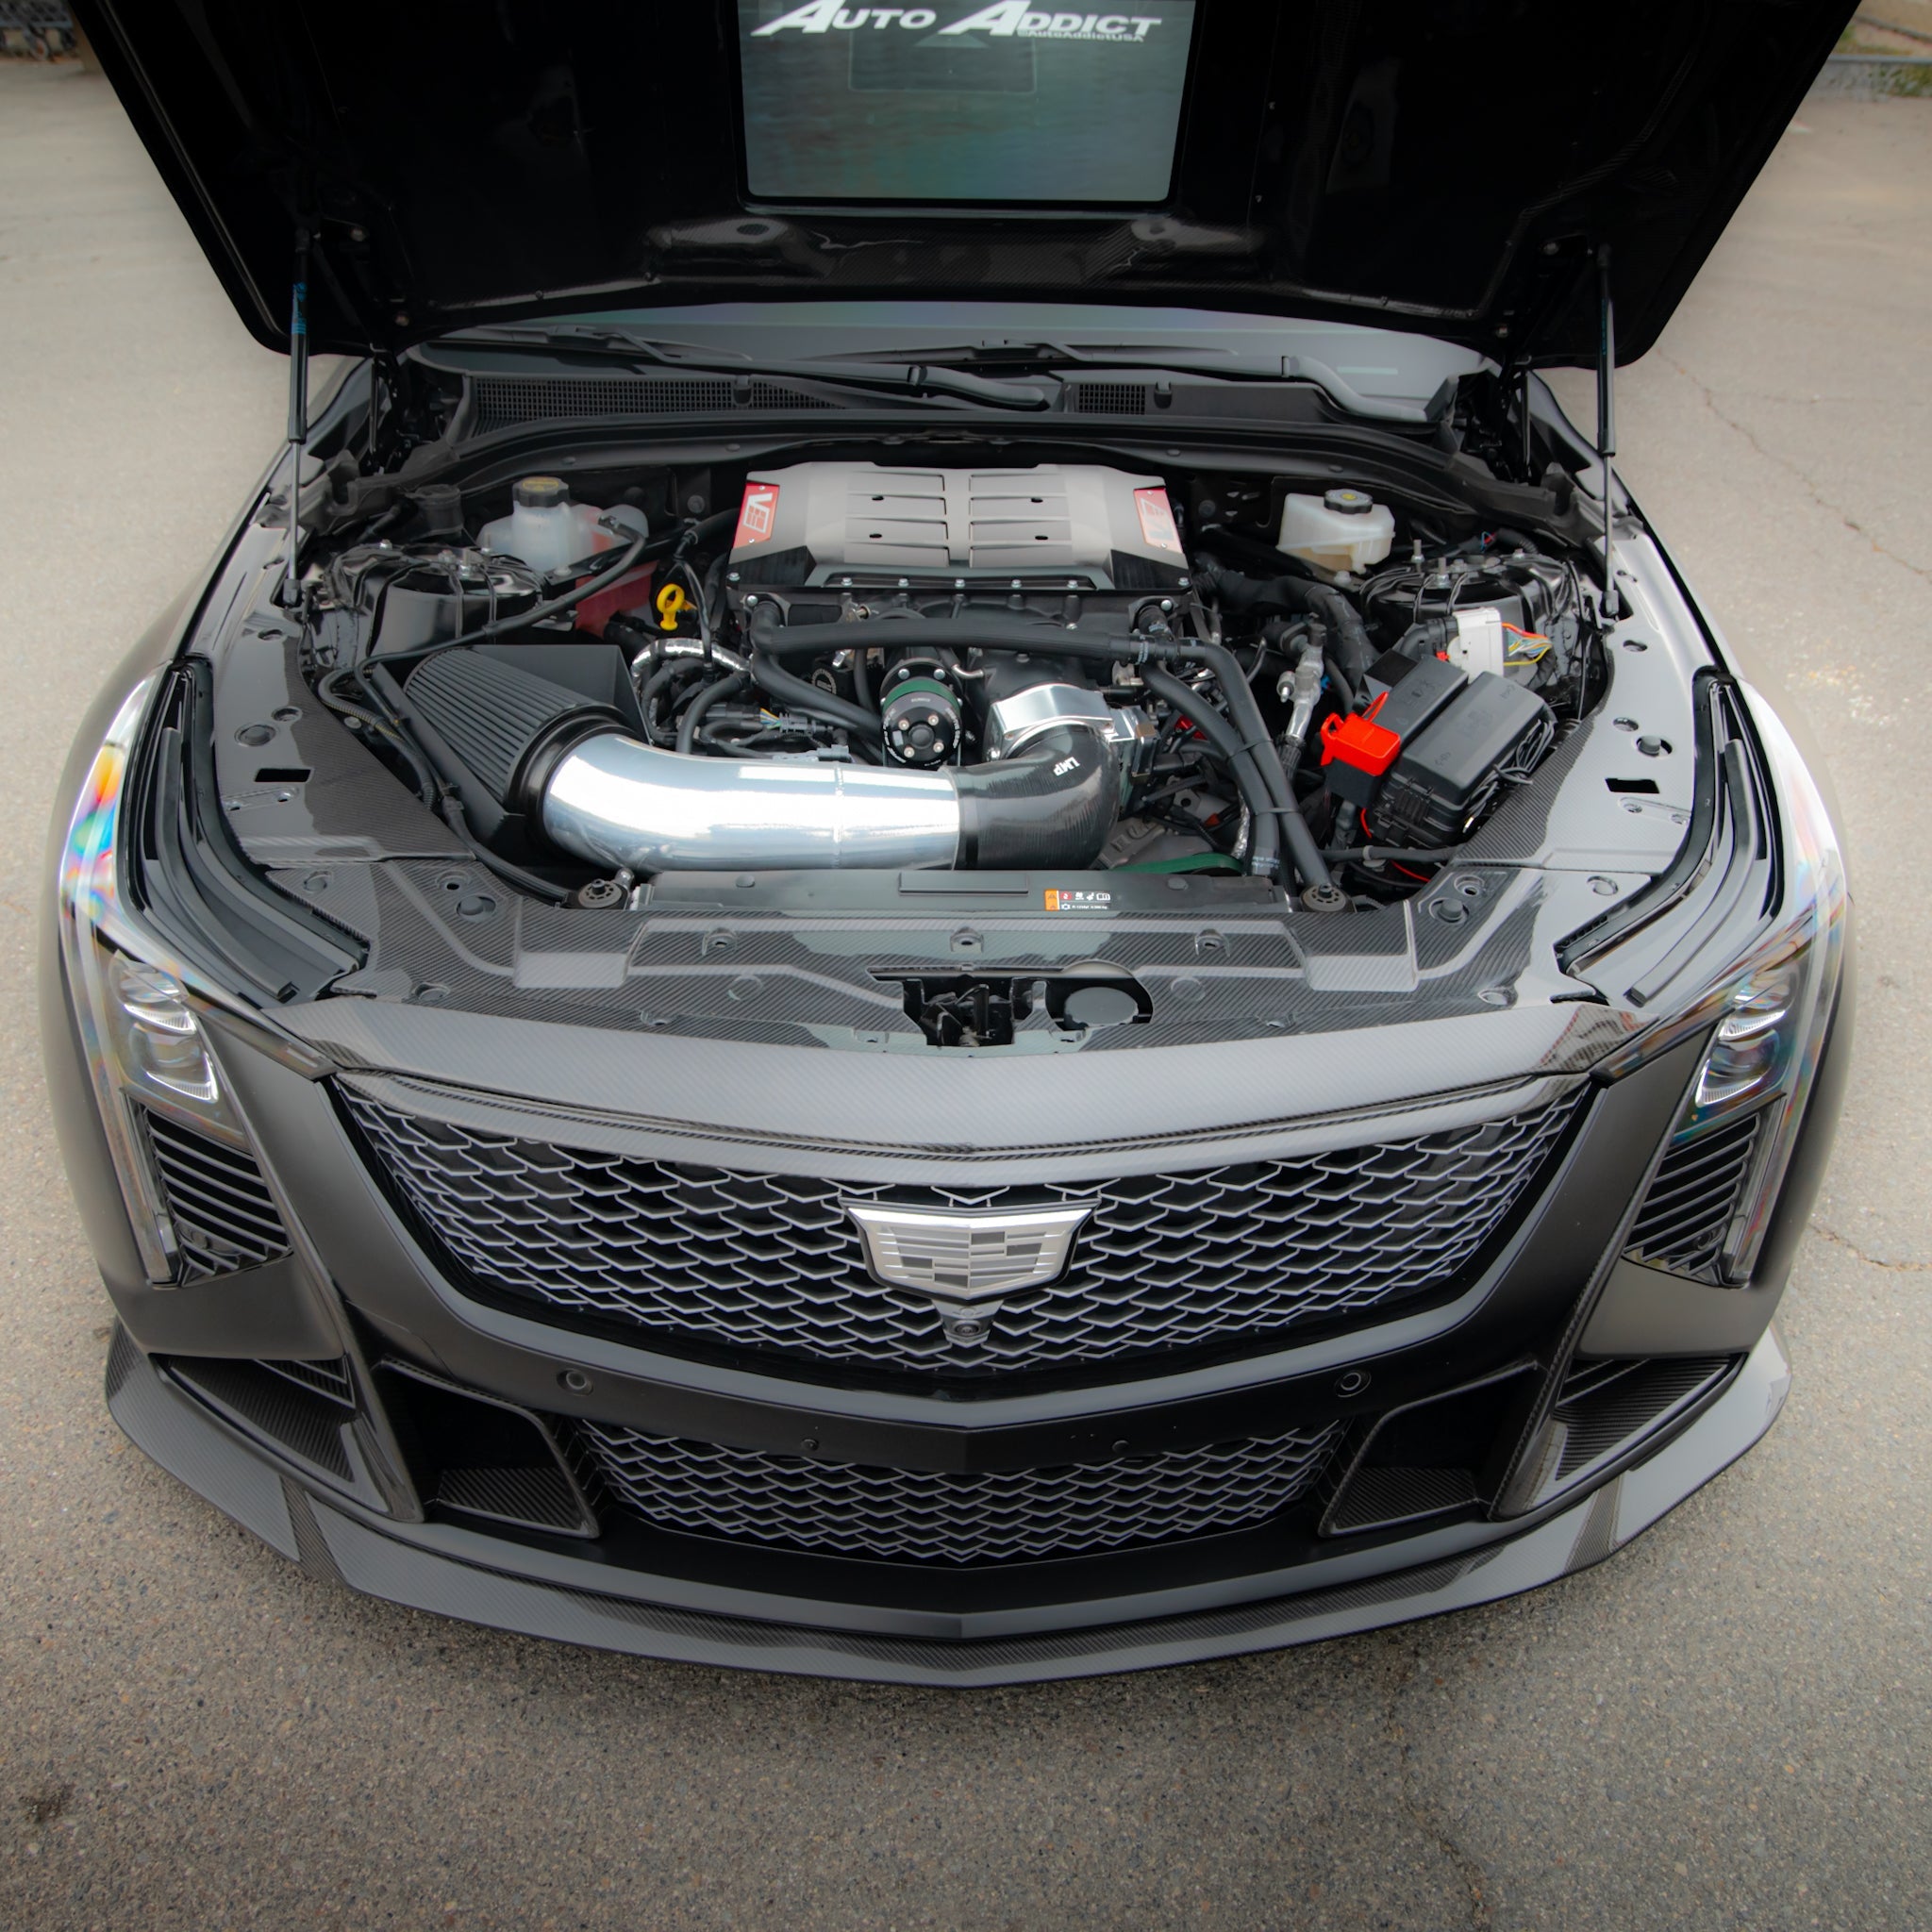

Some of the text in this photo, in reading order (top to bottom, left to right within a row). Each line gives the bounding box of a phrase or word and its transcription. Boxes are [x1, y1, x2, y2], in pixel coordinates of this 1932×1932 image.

[751, 0, 1162, 37] AUTO ADDICT
[1053, 756, 1081, 776] LMP
